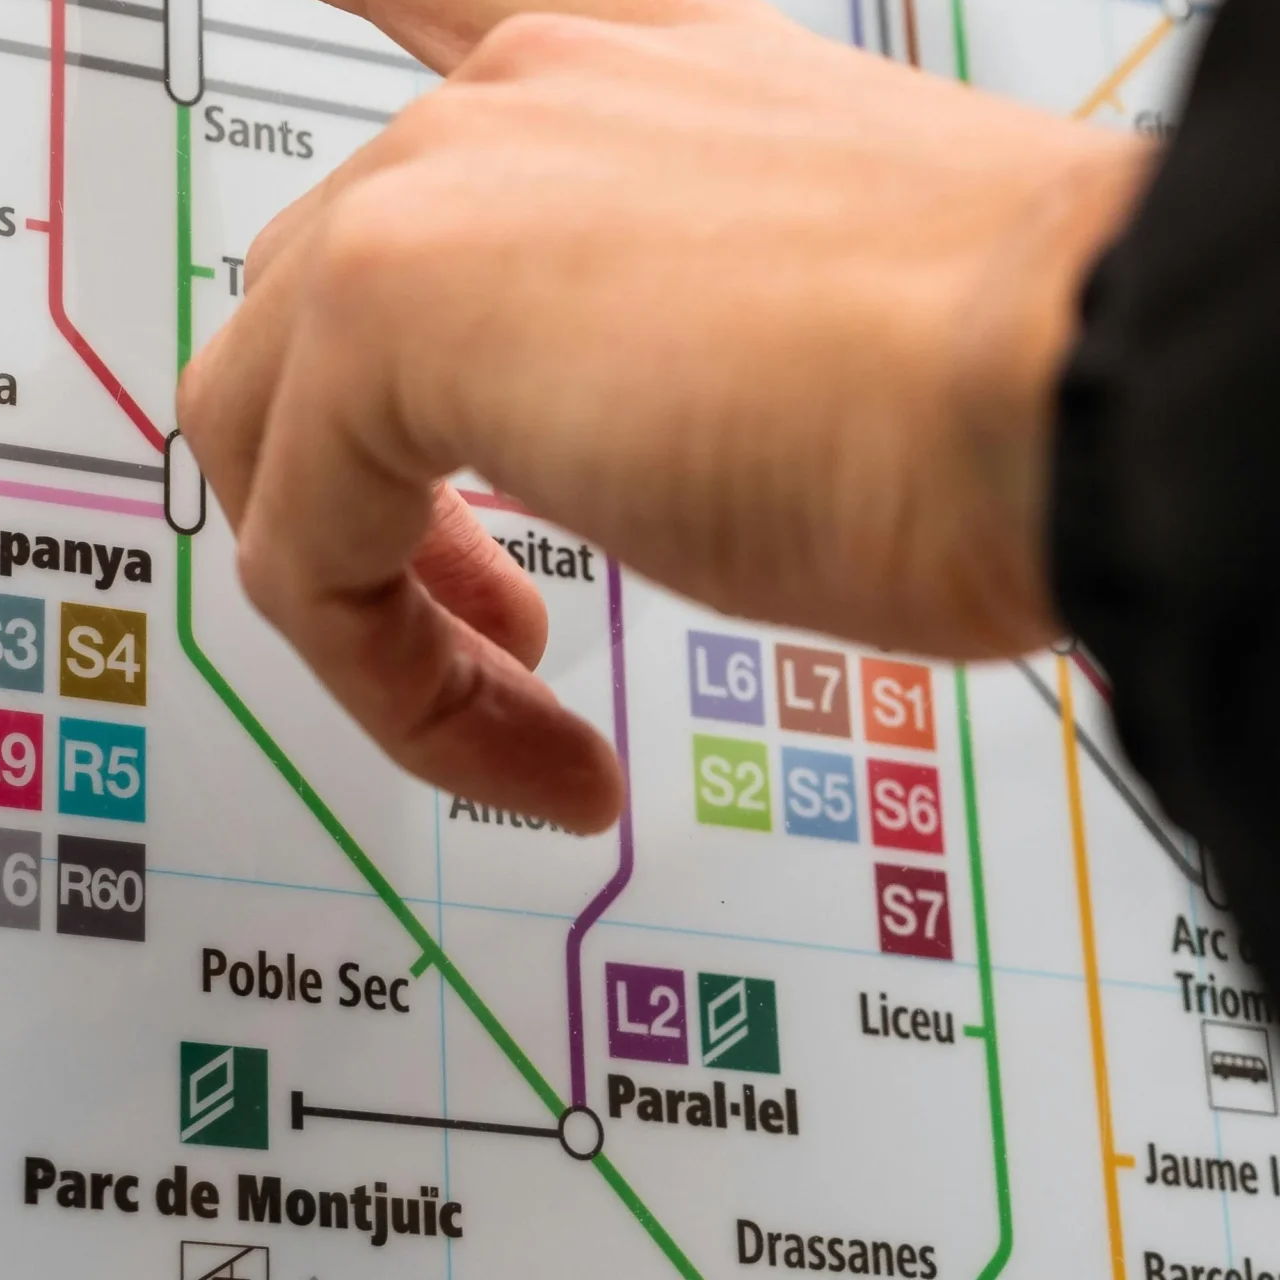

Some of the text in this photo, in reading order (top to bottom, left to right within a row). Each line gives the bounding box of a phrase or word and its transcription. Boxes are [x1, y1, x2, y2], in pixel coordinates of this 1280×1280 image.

[204, 105, 314, 159] Sants
[66, 626, 141, 683] S4
[695, 645, 927, 729] L6 L7 S1
[63, 740, 141, 801] R5
[700, 754, 938, 835] S2 S5 S6
[59, 865, 144, 913] R60
[883, 884, 944, 939] S7
[1173, 914, 1228, 961] Arc
[202, 947, 411, 1013] Poble Sec
[616, 980, 681, 1038] L2
[860, 992, 955, 1044] Liceu
[1146, 1142, 1259, 1195] Jaume
[24, 1156, 464, 1247] Parc de Montjuïc
[736, 1218, 938, 1280] Drassanes
